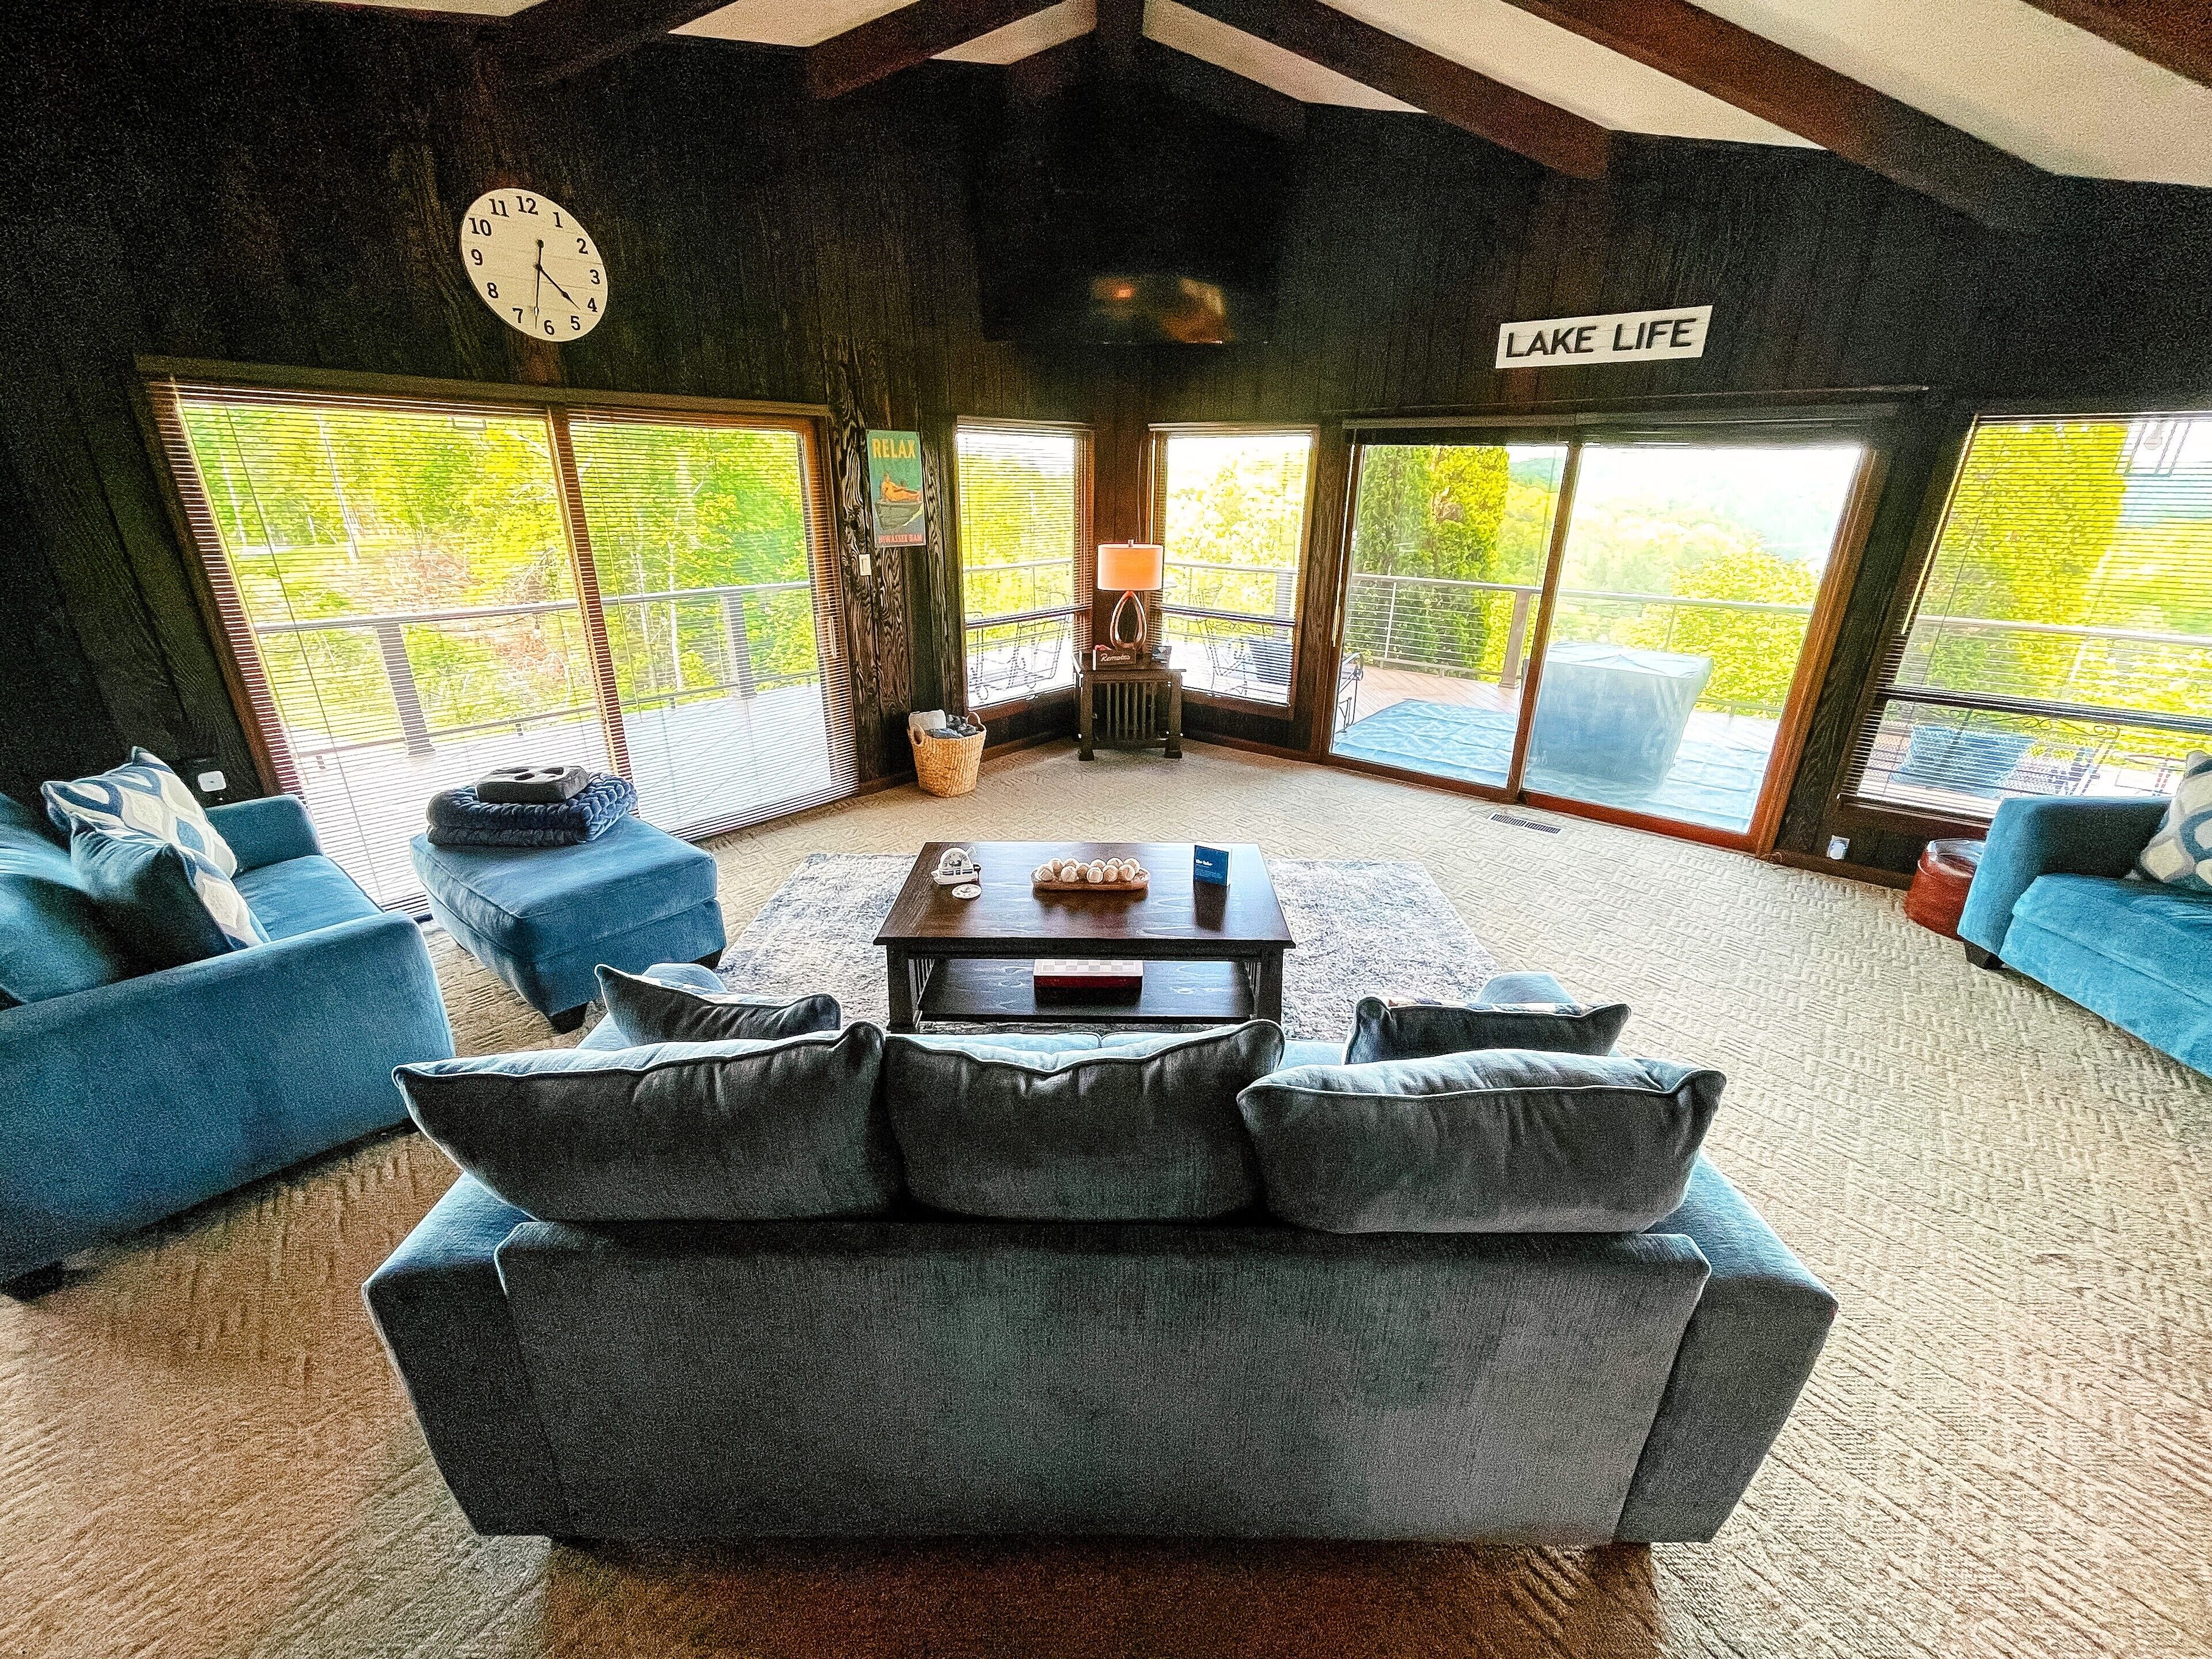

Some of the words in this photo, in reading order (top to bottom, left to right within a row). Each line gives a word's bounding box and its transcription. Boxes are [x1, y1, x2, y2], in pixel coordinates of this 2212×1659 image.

[489, 199, 509, 218] 11
[516, 196, 539, 215] 12
[469, 217, 492, 236] 10
[553, 212, 563, 228] 1
[577, 238, 588, 255] 2
[471, 249, 483, 266] 9
[590, 269, 600, 285] 3
[487, 282, 499, 299] 8
[588, 298, 598, 313] 4
[513, 308, 523, 324] 7
[570, 315, 581, 331] 5
[544, 320, 555, 335] 6
[1506, 325, 1597, 358] LAKE
[1612, 318, 1698, 351] LIFE
[872, 438, 916, 459] RELAX
[1100, 653, 1131, 662] Remotes
